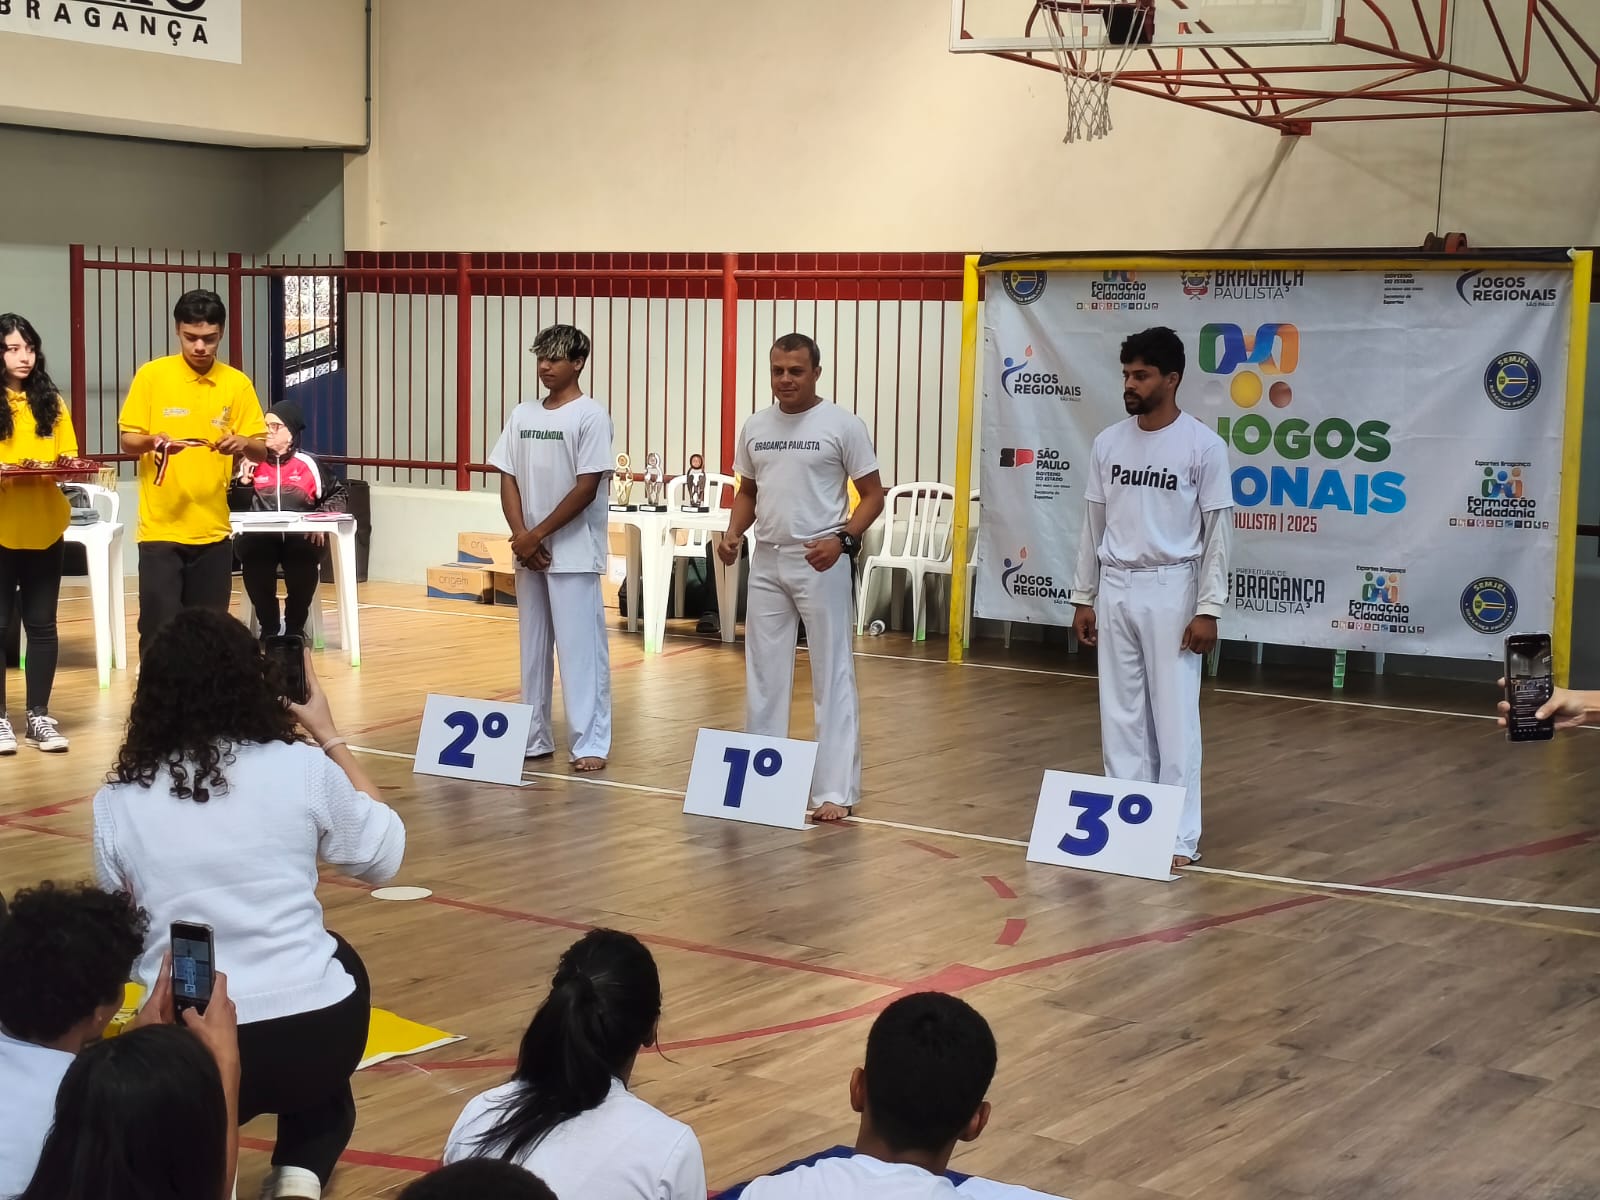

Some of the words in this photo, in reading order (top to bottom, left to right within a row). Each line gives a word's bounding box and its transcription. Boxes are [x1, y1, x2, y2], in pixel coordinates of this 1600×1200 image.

[0, 0, 208, 46] BRAGANÇA
[1092, 281, 1146, 293] Formação
[1215, 270, 1304, 292] BRAGANÇA
[1473, 277, 1526, 288] JOGOS
[1214, 287, 1284, 299] PAULISTA
[1473, 289, 1556, 301] REGIONAIS
[1014, 373, 1059, 384] JOGOS
[1014, 384, 1082, 397] REGIONAIS
[754, 440, 787, 452] BRAGANÇA
[788, 440, 820, 451] PAULISTA
[1037, 447, 1060, 460] SÃO
[1036, 460, 1070, 471] PAULO
[1110, 464, 1178, 491] Pauínia
[1231, 465, 1407, 515] ONAIS
[1467, 496, 1536, 511] Formação
[1234, 512, 1277, 531] ULISTA
[1287, 515, 1318, 533] 2025
[1236, 567, 1277, 577] PREFEITURA
[1013, 574, 1053, 587] JOGOS
[1013, 585, 1073, 600] REGIONAI
[1236, 574, 1325, 609] BRAGANÇA
[1235, 598, 1305, 615] PAULISTA
[1349, 600, 1410, 614] Formação
